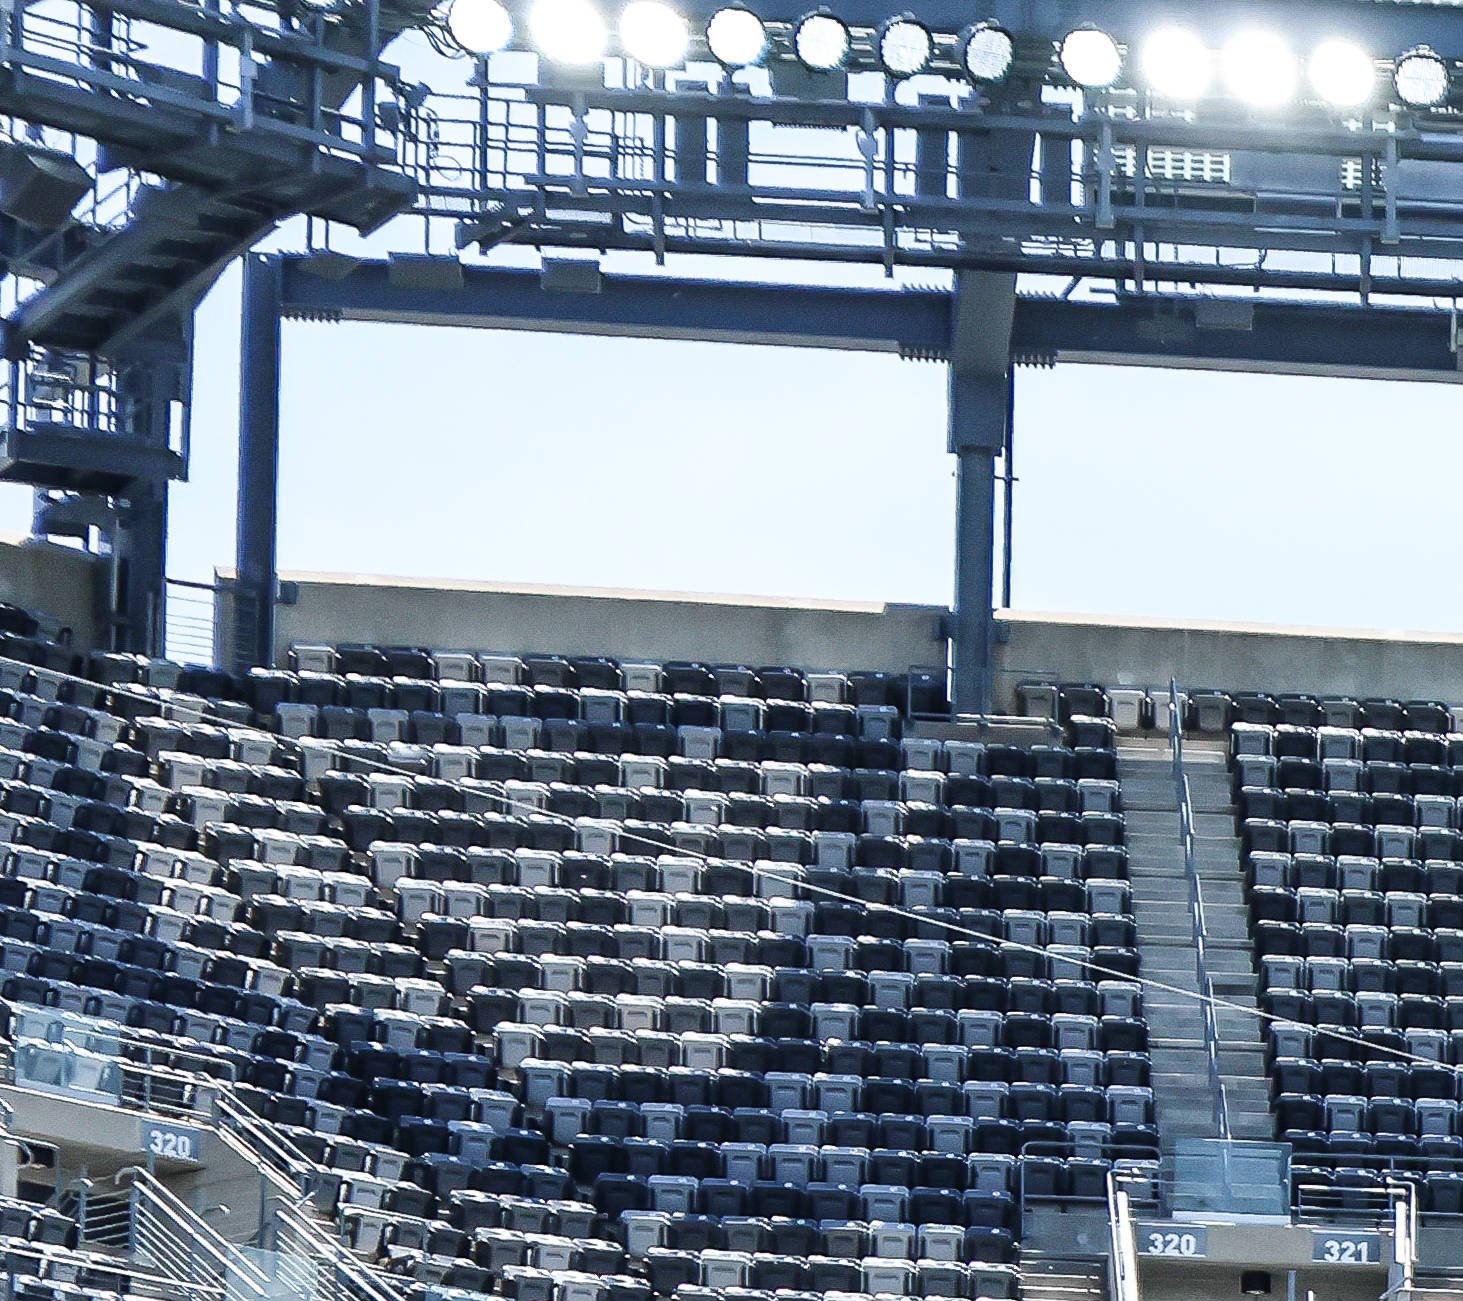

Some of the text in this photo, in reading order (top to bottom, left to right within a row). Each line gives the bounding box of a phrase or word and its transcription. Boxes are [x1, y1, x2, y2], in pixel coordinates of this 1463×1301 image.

[149, 1130, 192, 1159] 320
[1149, 1232, 1196, 1257] 320
[1325, 1238, 1371, 1264] 321
